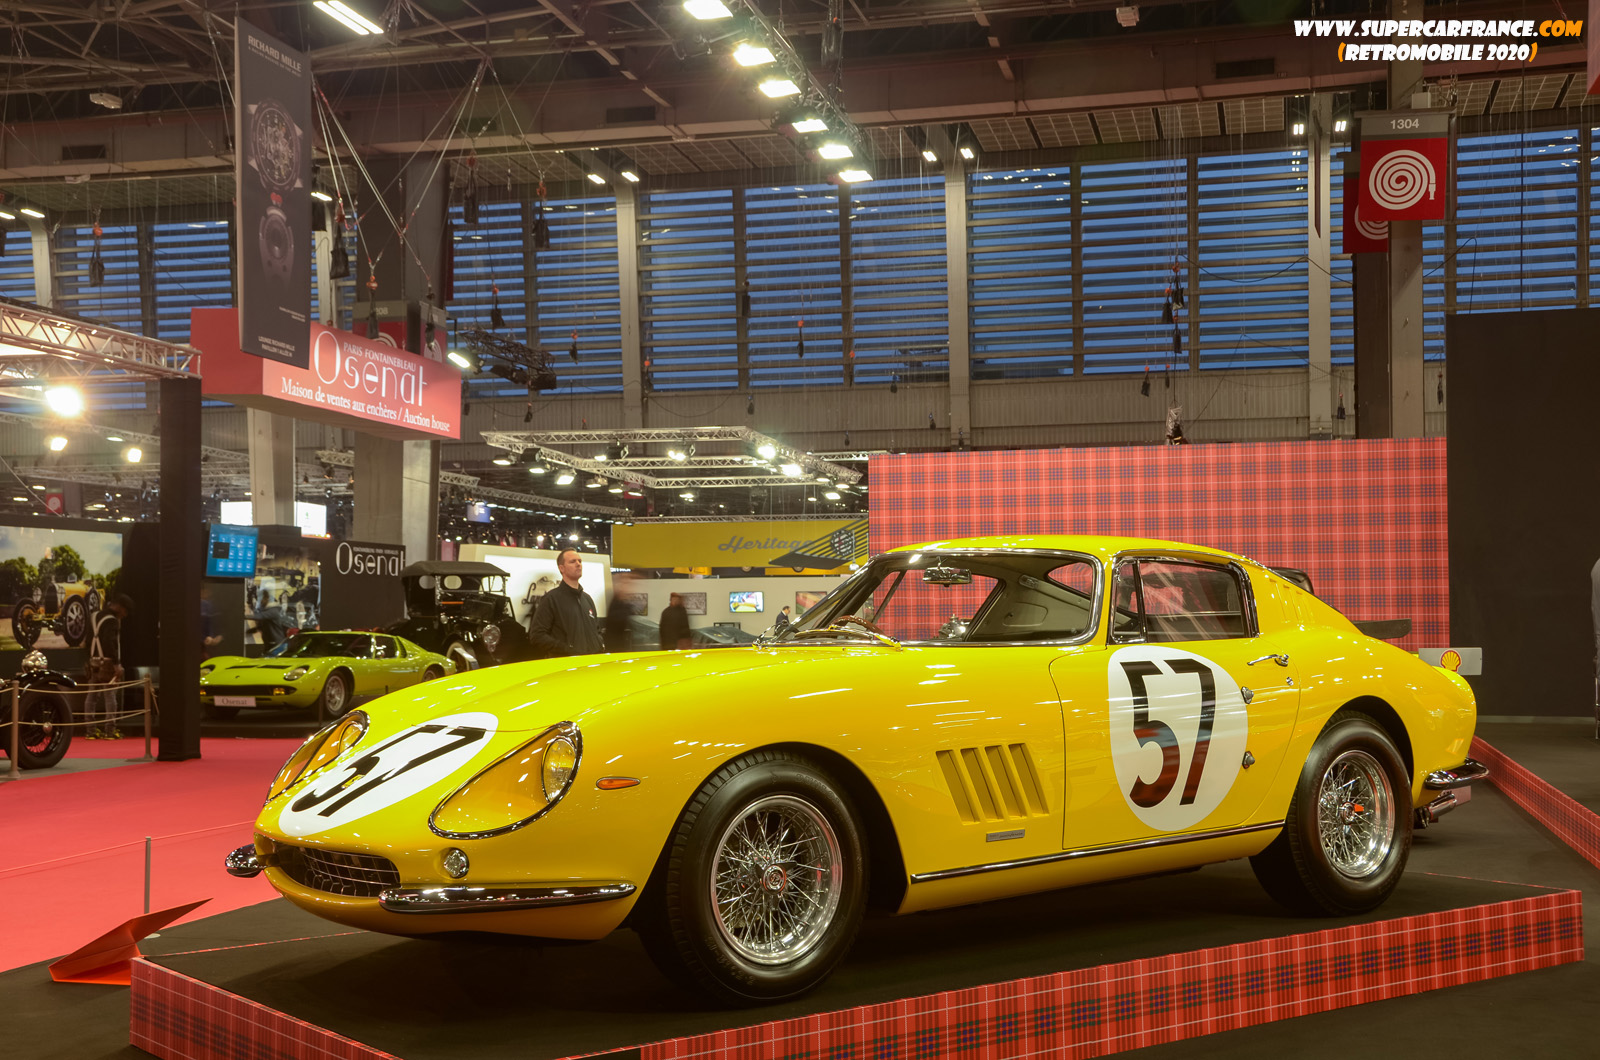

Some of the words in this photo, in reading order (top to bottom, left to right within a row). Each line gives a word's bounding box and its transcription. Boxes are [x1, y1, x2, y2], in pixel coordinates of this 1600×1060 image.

[248, 35, 279, 60] RICHARD
[281, 53, 301, 73] MILLE
[1390, 118, 1420, 130] 1304
[314, 331, 427, 406] Osenat
[343, 342, 363, 357] PARIS
[364, 348, 417, 373] FONTAINEBLEAU
[281, 376, 314, 400] Maison
[314, 385, 326, 403] de
[326, 391, 351, 409] ventes
[352, 399, 366, 413] aux
[366, 401, 398, 421] enchères
[403, 408, 431, 428] Auction
[431, 414, 451, 432] house
[335, 541, 406, 577] Osenat
[1119, 658, 1217, 809] 57
[291, 724, 487, 818] 57
